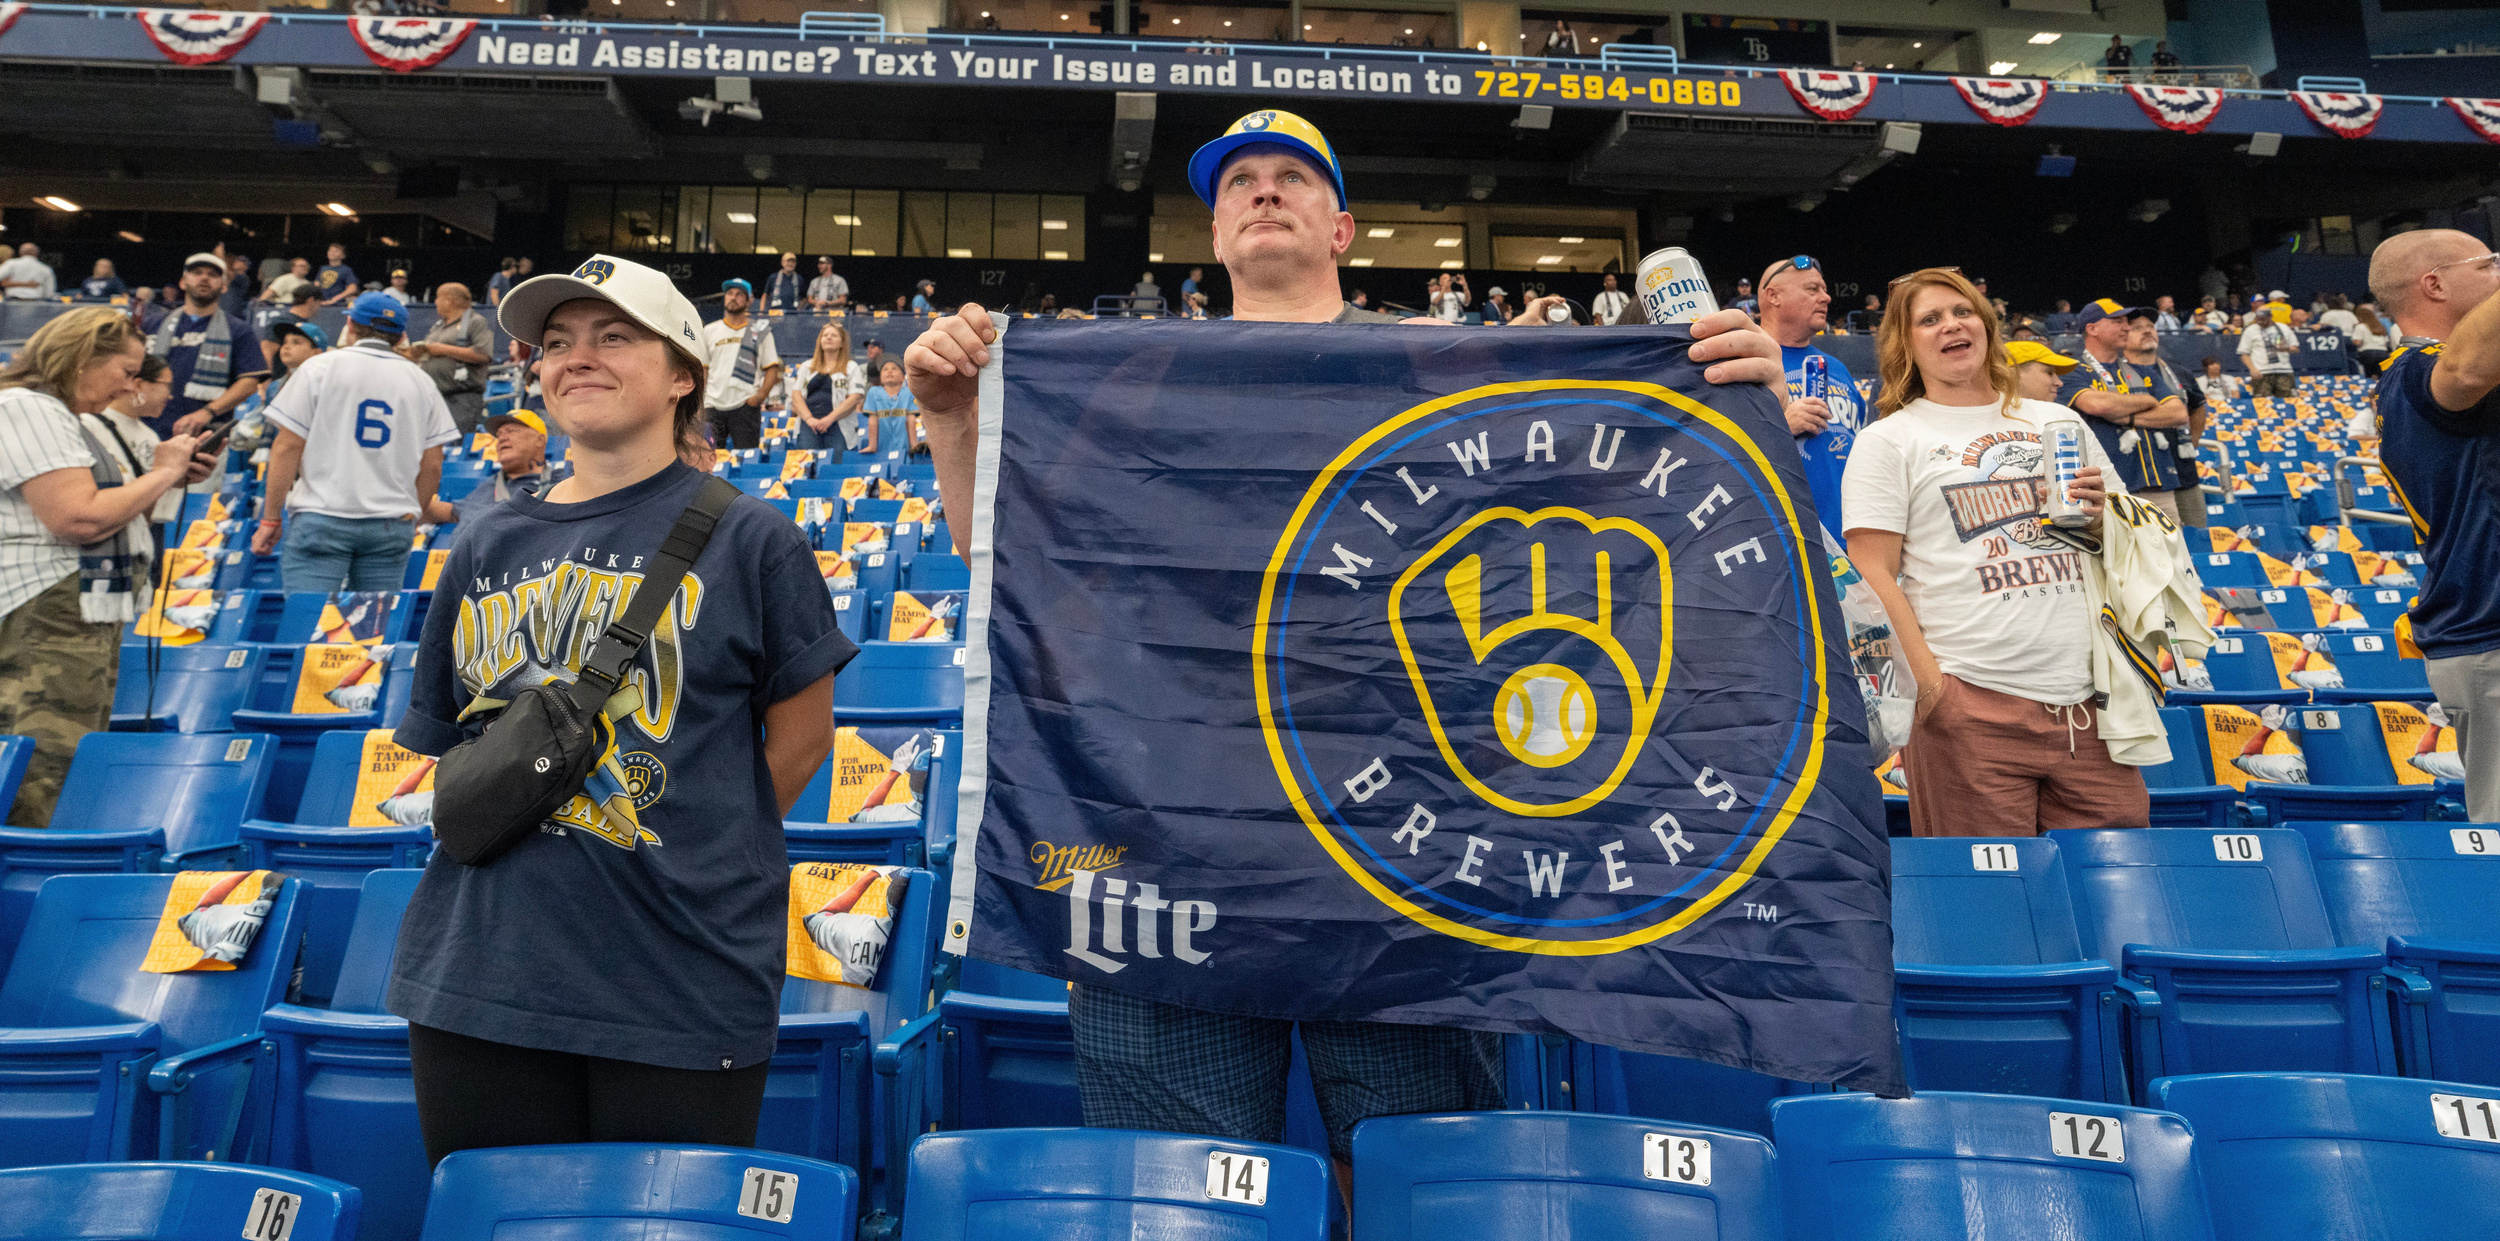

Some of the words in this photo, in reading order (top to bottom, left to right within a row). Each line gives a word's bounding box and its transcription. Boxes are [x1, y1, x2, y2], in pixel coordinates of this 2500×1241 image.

[1744, 38, 1769, 61] TB
[478, 36, 580, 66] Need
[592, 40, 841, 74] Assistance?
[854, 48, 937, 76] Text
[951, 51, 1038, 80] Your
[1054, 54, 1156, 84] Issue
[1170, 60, 1237, 87] and
[1253, 62, 1412, 93] Location
[1425, 69, 1461, 95] to
[1475, 71, 1741, 107] 727-594-0860
[666, 263, 692, 280] 125
[981, 270, 1006, 285] 127
[1834, 282, 1859, 298] 129
[2125, 277, 2146, 292] 131
[1643, 278, 1709, 320] Corona
[1654, 300, 1697, 325] Extra
[2306, 335, 2339, 351] 129
[1817, 373, 1825, 400] LTRA
[355, 399, 393, 448] 6
[1961, 430, 2043, 469] MILWAUK
[1320, 420, 1767, 589] MILWAUKEE
[1949, 482, 2036, 532] WORLD
[1982, 535, 2010, 559] 20
[2217, 556, 2223, 564] 4
[1975, 552, 2083, 595] BREWE
[836, 597, 846, 609] 16
[2270, 592, 2278, 602] 5
[2385, 592, 2393, 602] 4
[895, 610, 926, 618] TAMPA
[2224, 639, 2231, 652] 7
[2363, 637, 2373, 650] 6
[2213, 714, 2258, 727] TAMPA
[2215, 723, 2239, 734] BAY
[2316, 712, 2327, 728] 8
[2384, 715, 2426, 725] TAMPA
[2387, 724, 2409, 733] BAY
[231, 742, 246, 759] 18
[374, 752, 422, 762] TAMPA
[372, 762, 400, 772] BAY
[622, 756, 660, 775] LWAUKEE
[840, 764, 885, 775] TAMPA
[841, 757, 859, 765] FOR
[840, 775, 864, 786] BAY
[1344, 757, 1738, 898] BREWERS
[2223, 837, 2253, 860] 10
[2468, 831, 2485, 853] 9
[1030, 841, 1129, 885] Miller
[1982, 845, 2008, 870] 11
[807, 866, 841, 881] BAY
[1063, 869, 1218, 974] Lite
[1743, 902, 1778, 923] TM
[2450, 1099, 2498, 1140] 11
[2064, 1117, 2108, 1159] 12
[1658, 1138, 1697, 1181] 13
[1220, 1156, 1254, 1200] 14
[752, 1172, 786, 1219] 15
[255, 1193, 290, 1241] 16
